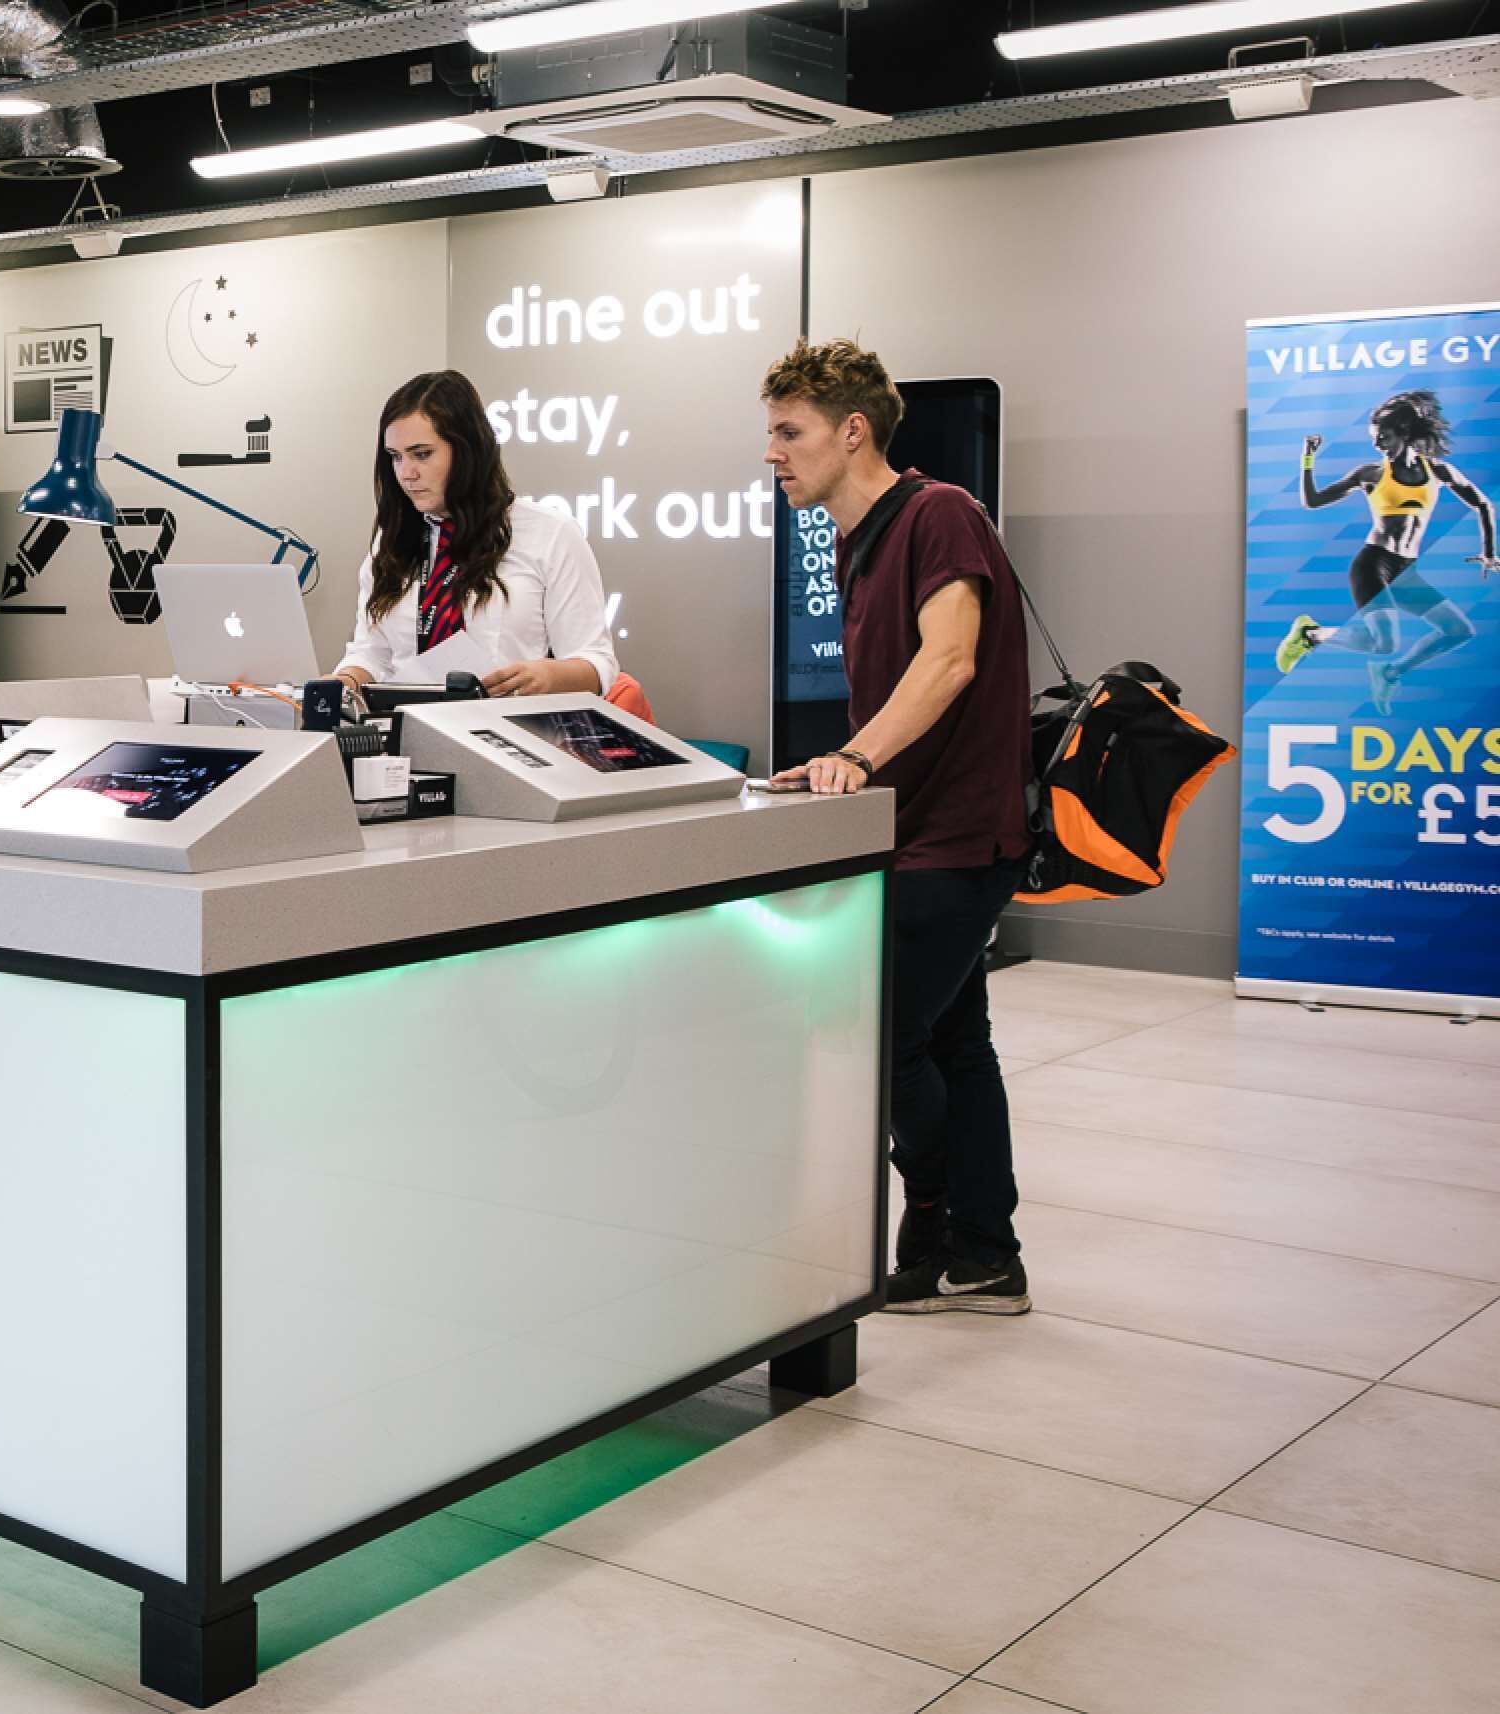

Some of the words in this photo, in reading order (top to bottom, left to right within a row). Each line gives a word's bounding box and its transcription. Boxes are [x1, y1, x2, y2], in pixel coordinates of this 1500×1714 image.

[485, 283, 624, 349] dine
[643, 272, 762, 338] out
[19, 338, 87, 366] NEWS
[1266, 338, 1428, 374] VILLAGE
[485, 391, 629, 456] stay,
[514, 476, 639, 540] rk
[655, 480, 773, 540] out
[806, 572, 838, 595] AS
[1262, 724, 1346, 844] 5
[1351, 726, 1500, 775] DAYS
[1351, 781, 1412, 805] FOR
[1251, 873, 1276, 885] BUY
[1278, 875, 1292, 885] IN
[1294, 876, 1325, 887] CLUB
[1328, 877, 1345, 888] OR
[1348, 878, 1394, 890] ONLINE
